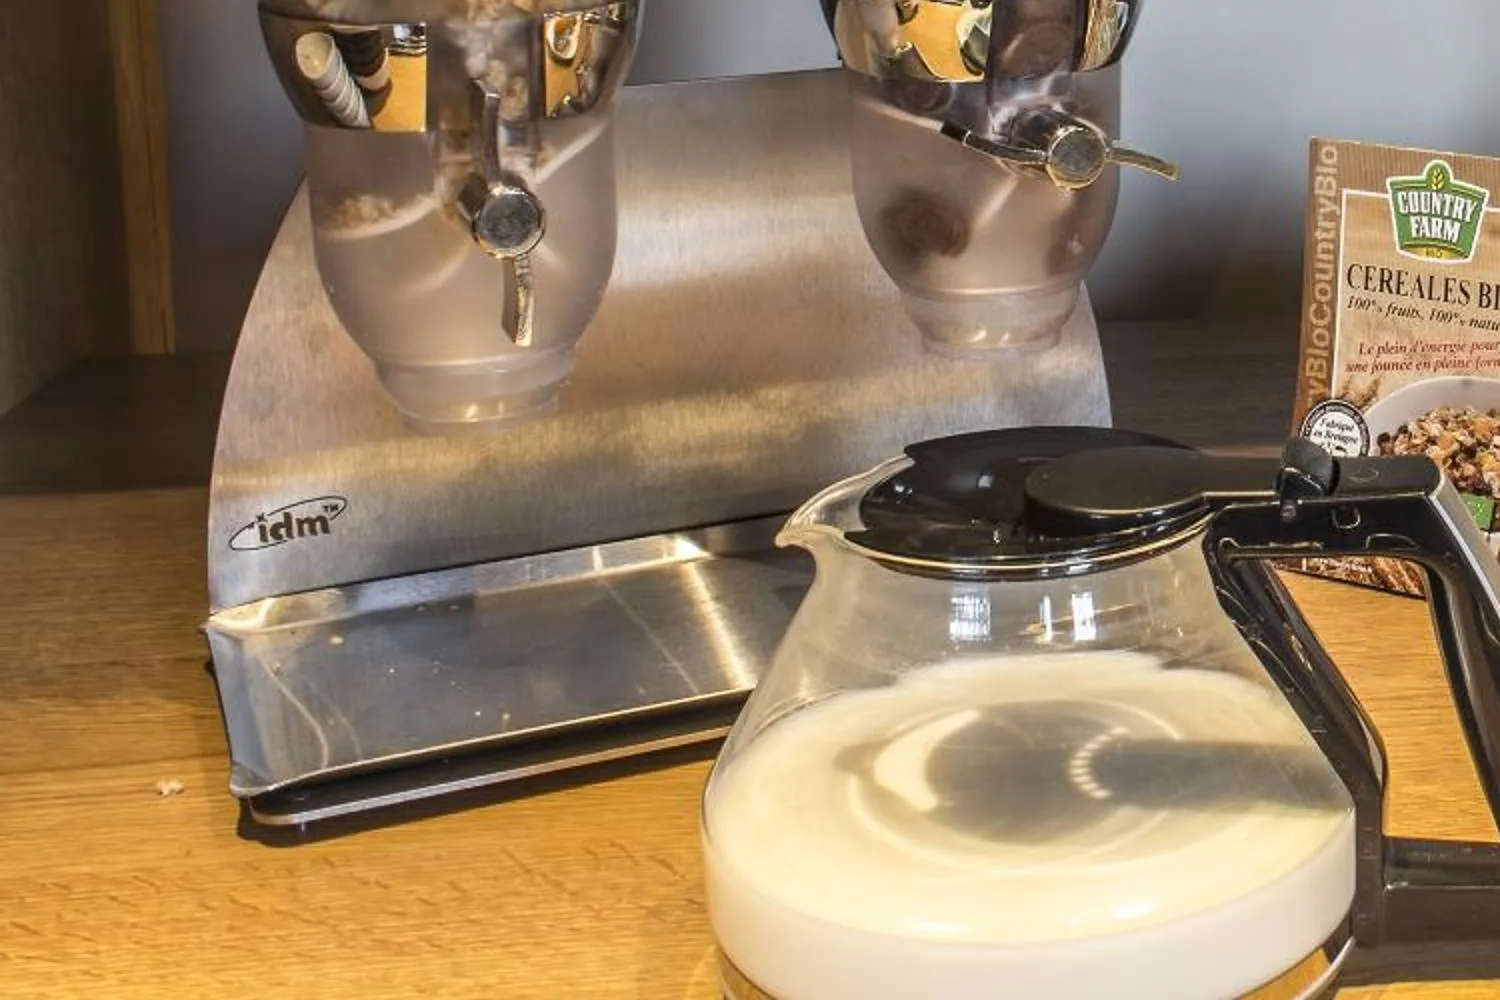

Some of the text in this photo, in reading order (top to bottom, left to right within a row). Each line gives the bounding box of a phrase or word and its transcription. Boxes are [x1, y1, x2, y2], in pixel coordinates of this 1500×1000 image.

[1397, 191, 1478, 223] COUNTRY
[1409, 215, 1461, 244] FARM
[1346, 263, 1471, 307] CEREALES
[1347, 295, 1383, 313] 100%
[1429, 308, 1465, 327] 100%
[1345, 362, 1369, 374] une
[1415, 359, 1431, 371] en
[1433, 355, 1472, 373] pleine
[1359, 342, 1374, 356] Le
[1376, 340, 1408, 359] plein
[257, 512, 331, 543] idm
